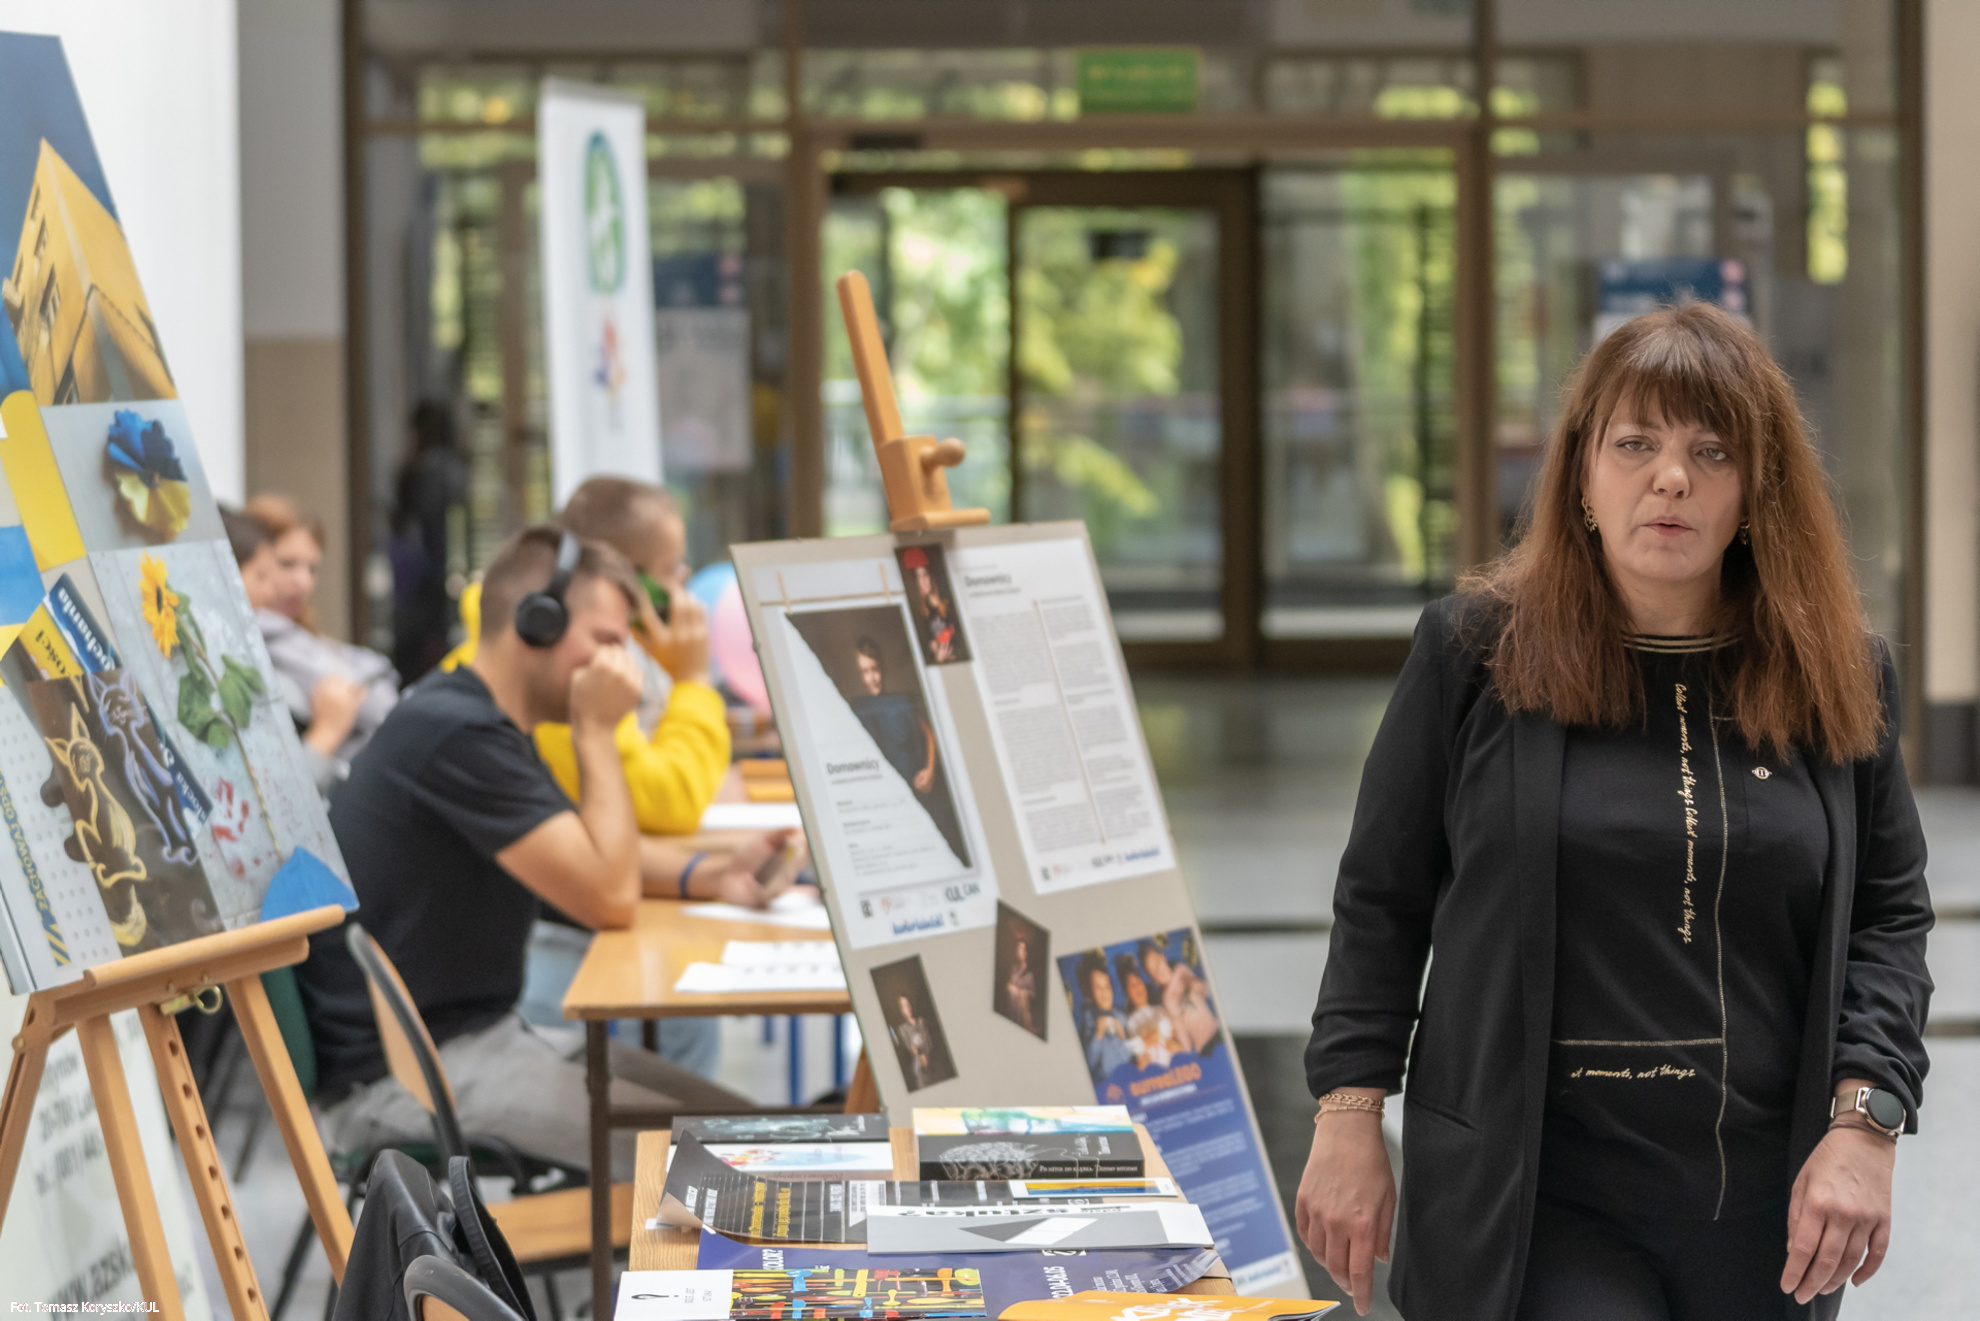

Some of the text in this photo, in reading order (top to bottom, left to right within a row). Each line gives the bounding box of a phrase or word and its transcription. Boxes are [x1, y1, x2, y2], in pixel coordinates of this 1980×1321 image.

[1677, 906, 1697, 944] things
[1585, 1067, 1632, 1080] moments,
[1636, 1066, 1658, 1078] not
[1659, 1063, 1696, 1080] things
